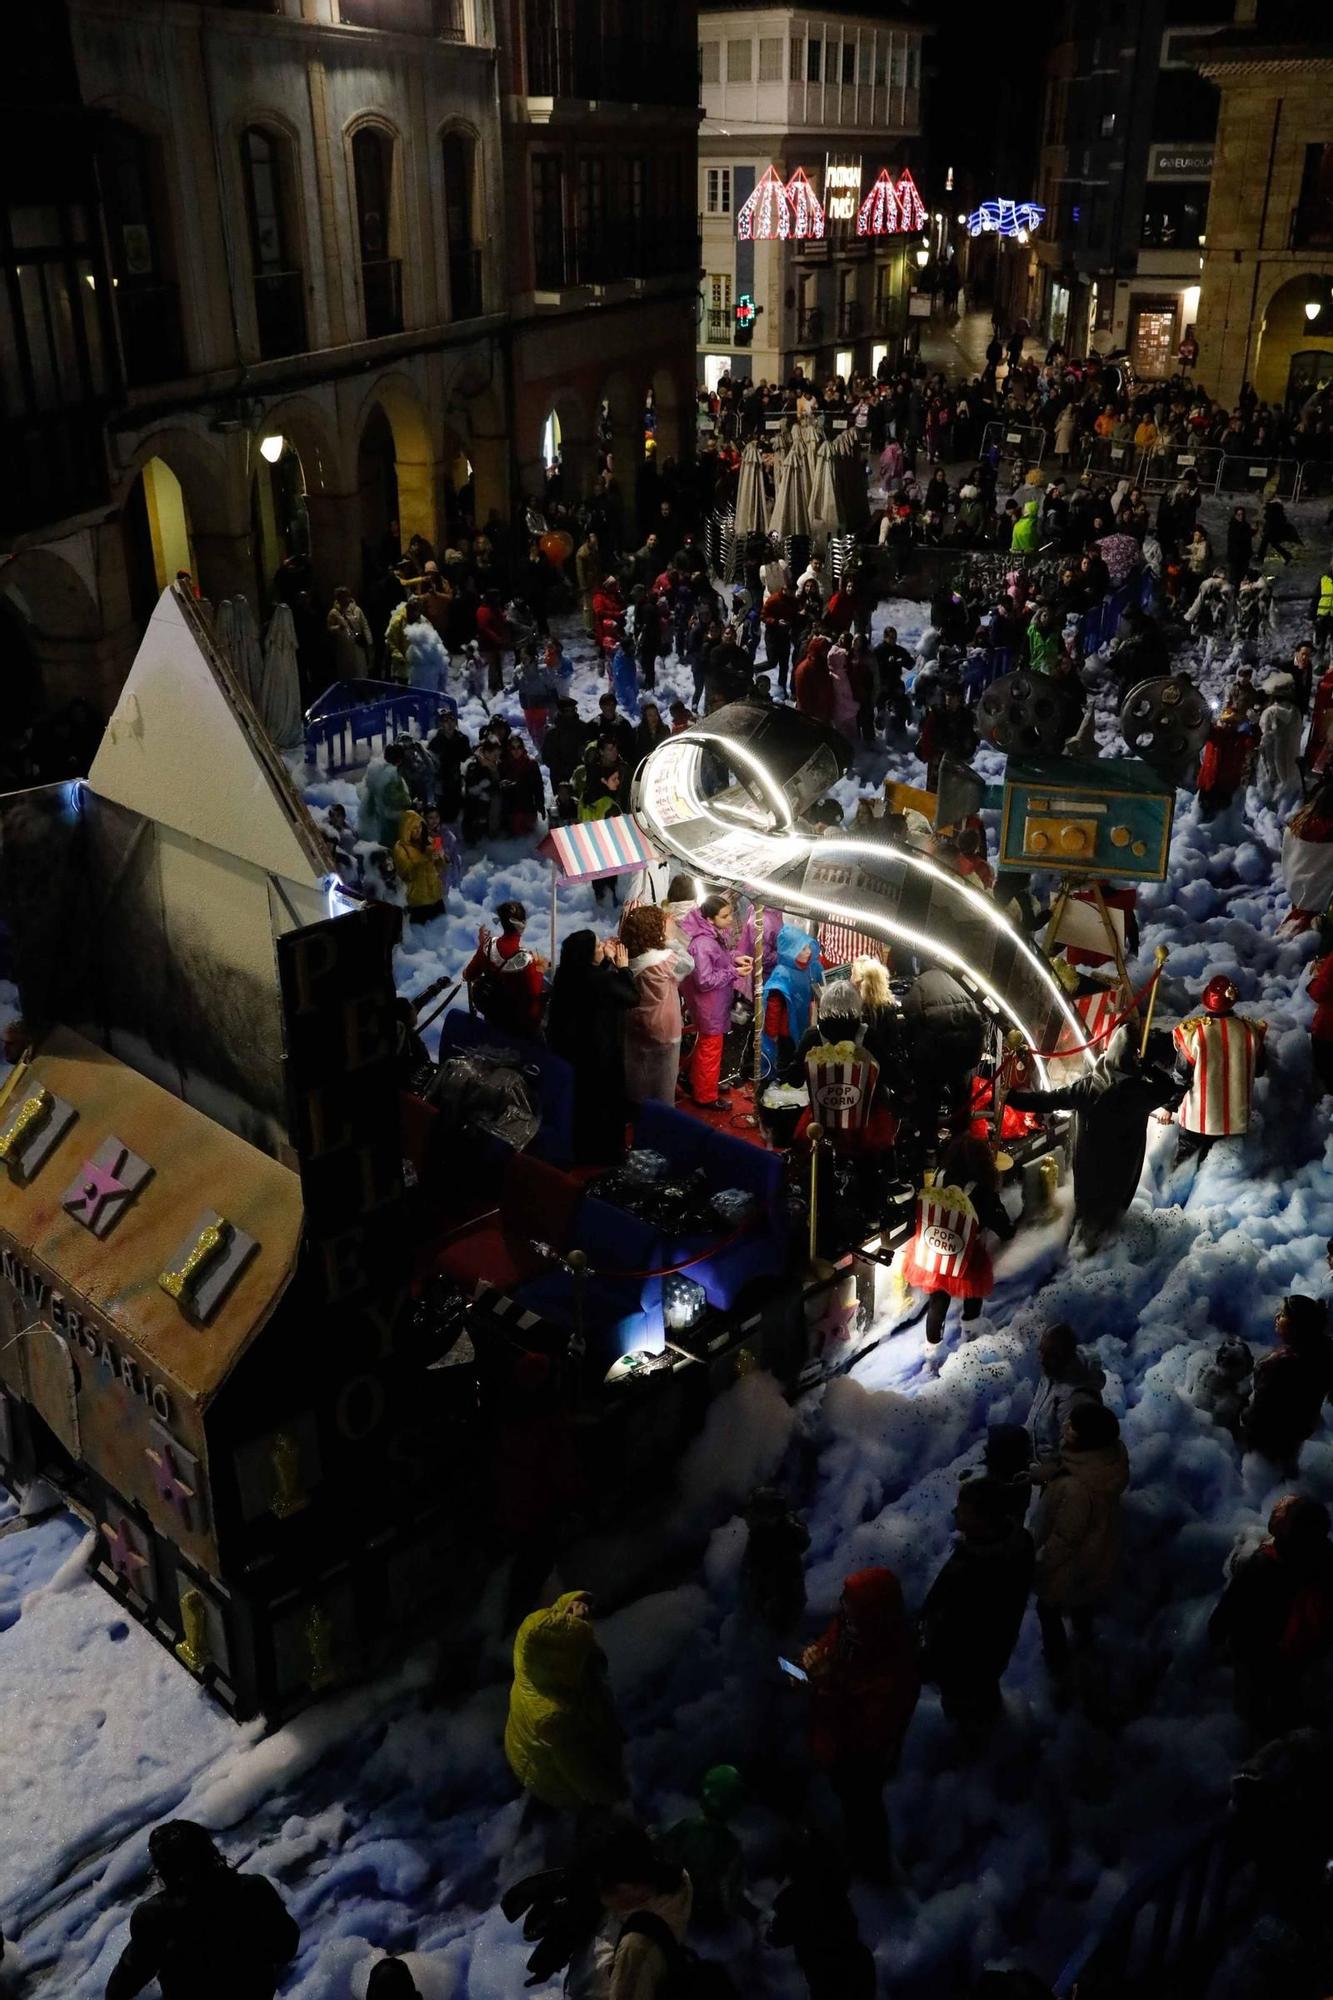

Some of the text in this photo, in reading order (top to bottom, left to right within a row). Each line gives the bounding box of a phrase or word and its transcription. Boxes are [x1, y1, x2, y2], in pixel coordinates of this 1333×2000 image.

[827, 1087, 852, 1096] POP
[823, 1096, 855, 1105] CORN
[933, 1228, 955, 1241] POP
[928, 1236, 957, 1252] CORN
